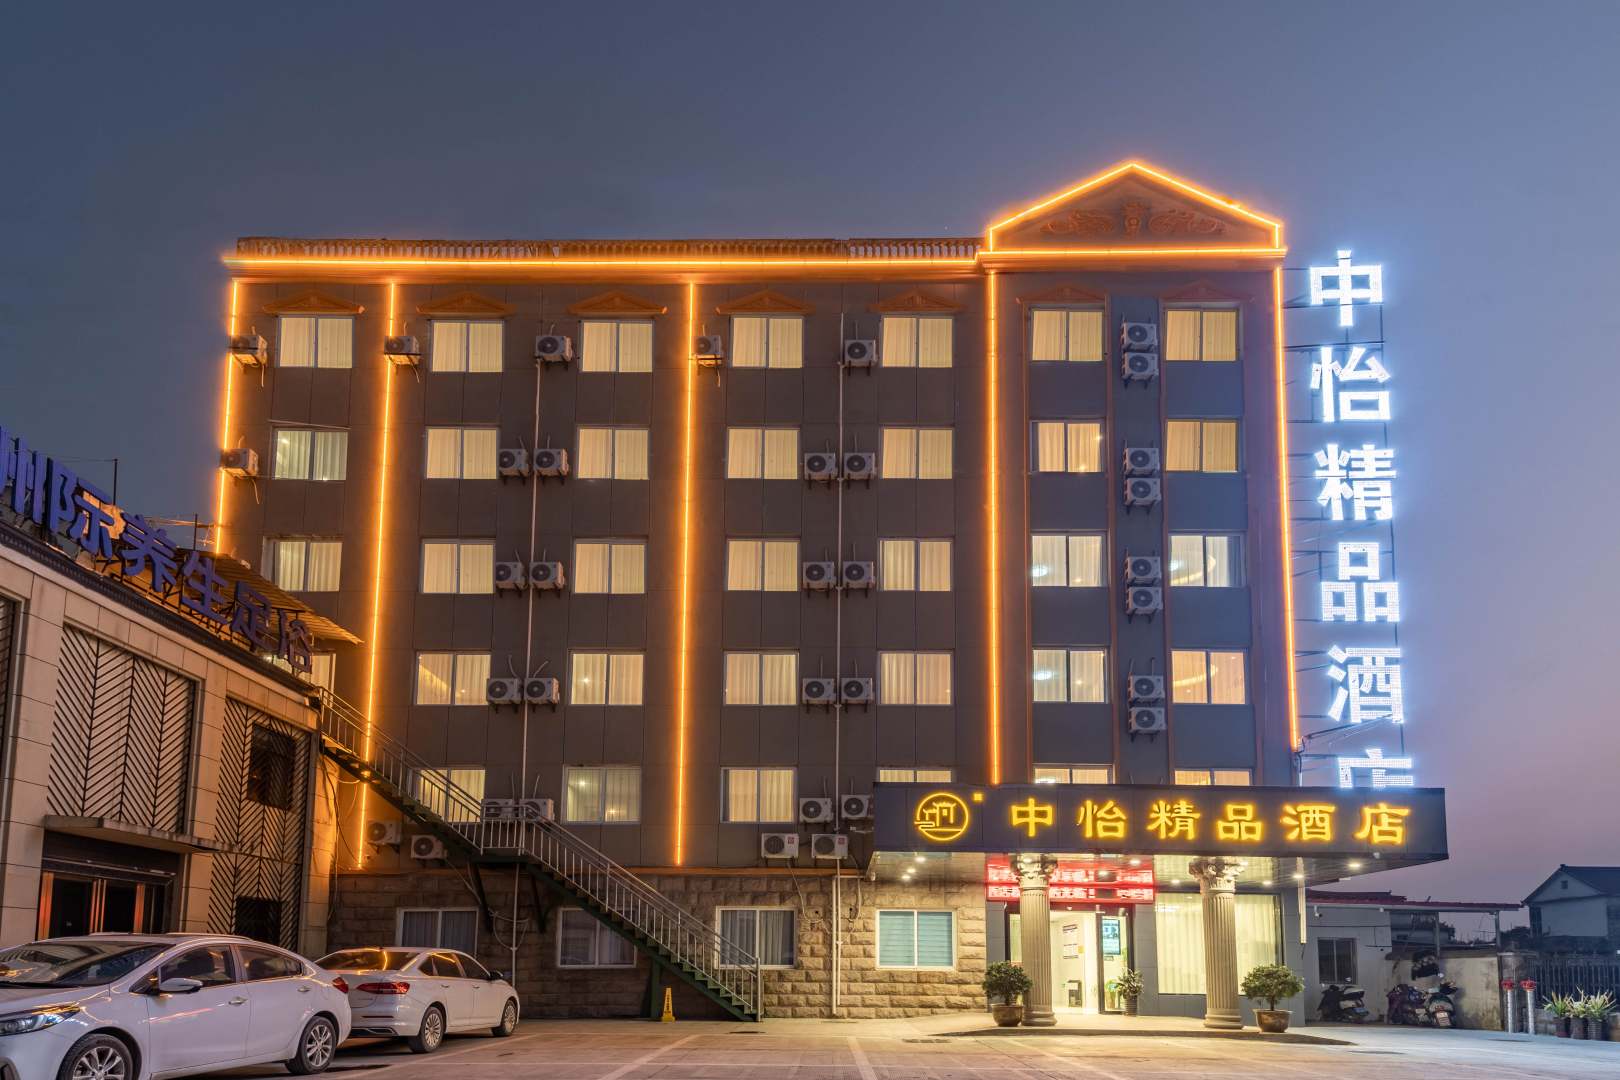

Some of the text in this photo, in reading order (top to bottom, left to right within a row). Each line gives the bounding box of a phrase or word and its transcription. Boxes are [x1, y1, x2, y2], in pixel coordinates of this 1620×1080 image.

[1010, 798, 1410, 844] 中怡精品酒店
